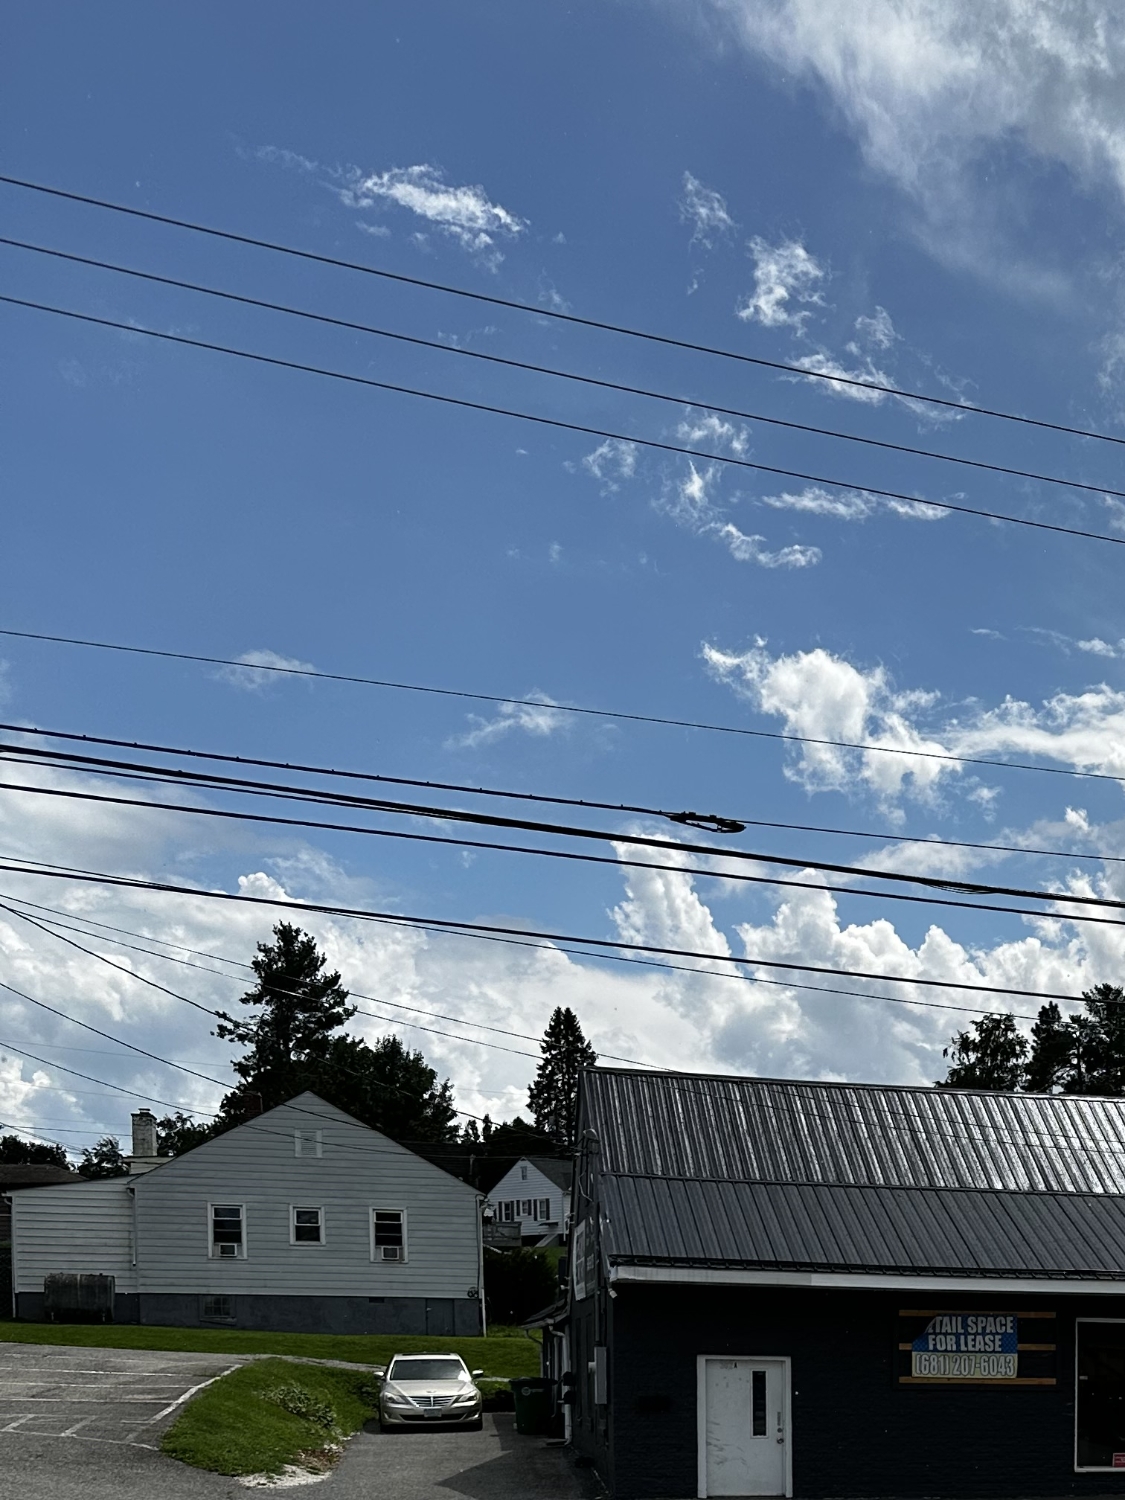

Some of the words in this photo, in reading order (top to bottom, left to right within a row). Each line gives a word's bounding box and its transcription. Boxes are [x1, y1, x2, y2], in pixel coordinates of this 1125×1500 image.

[967, 1317, 1014, 1334] SPACE
[928, 1335, 957, 1351] FOR
[960, 1335, 1002, 1352] LEASE
[916, 1354, 950, 1375] (681)
[952, 1355, 1014, 1376] 207-6043
